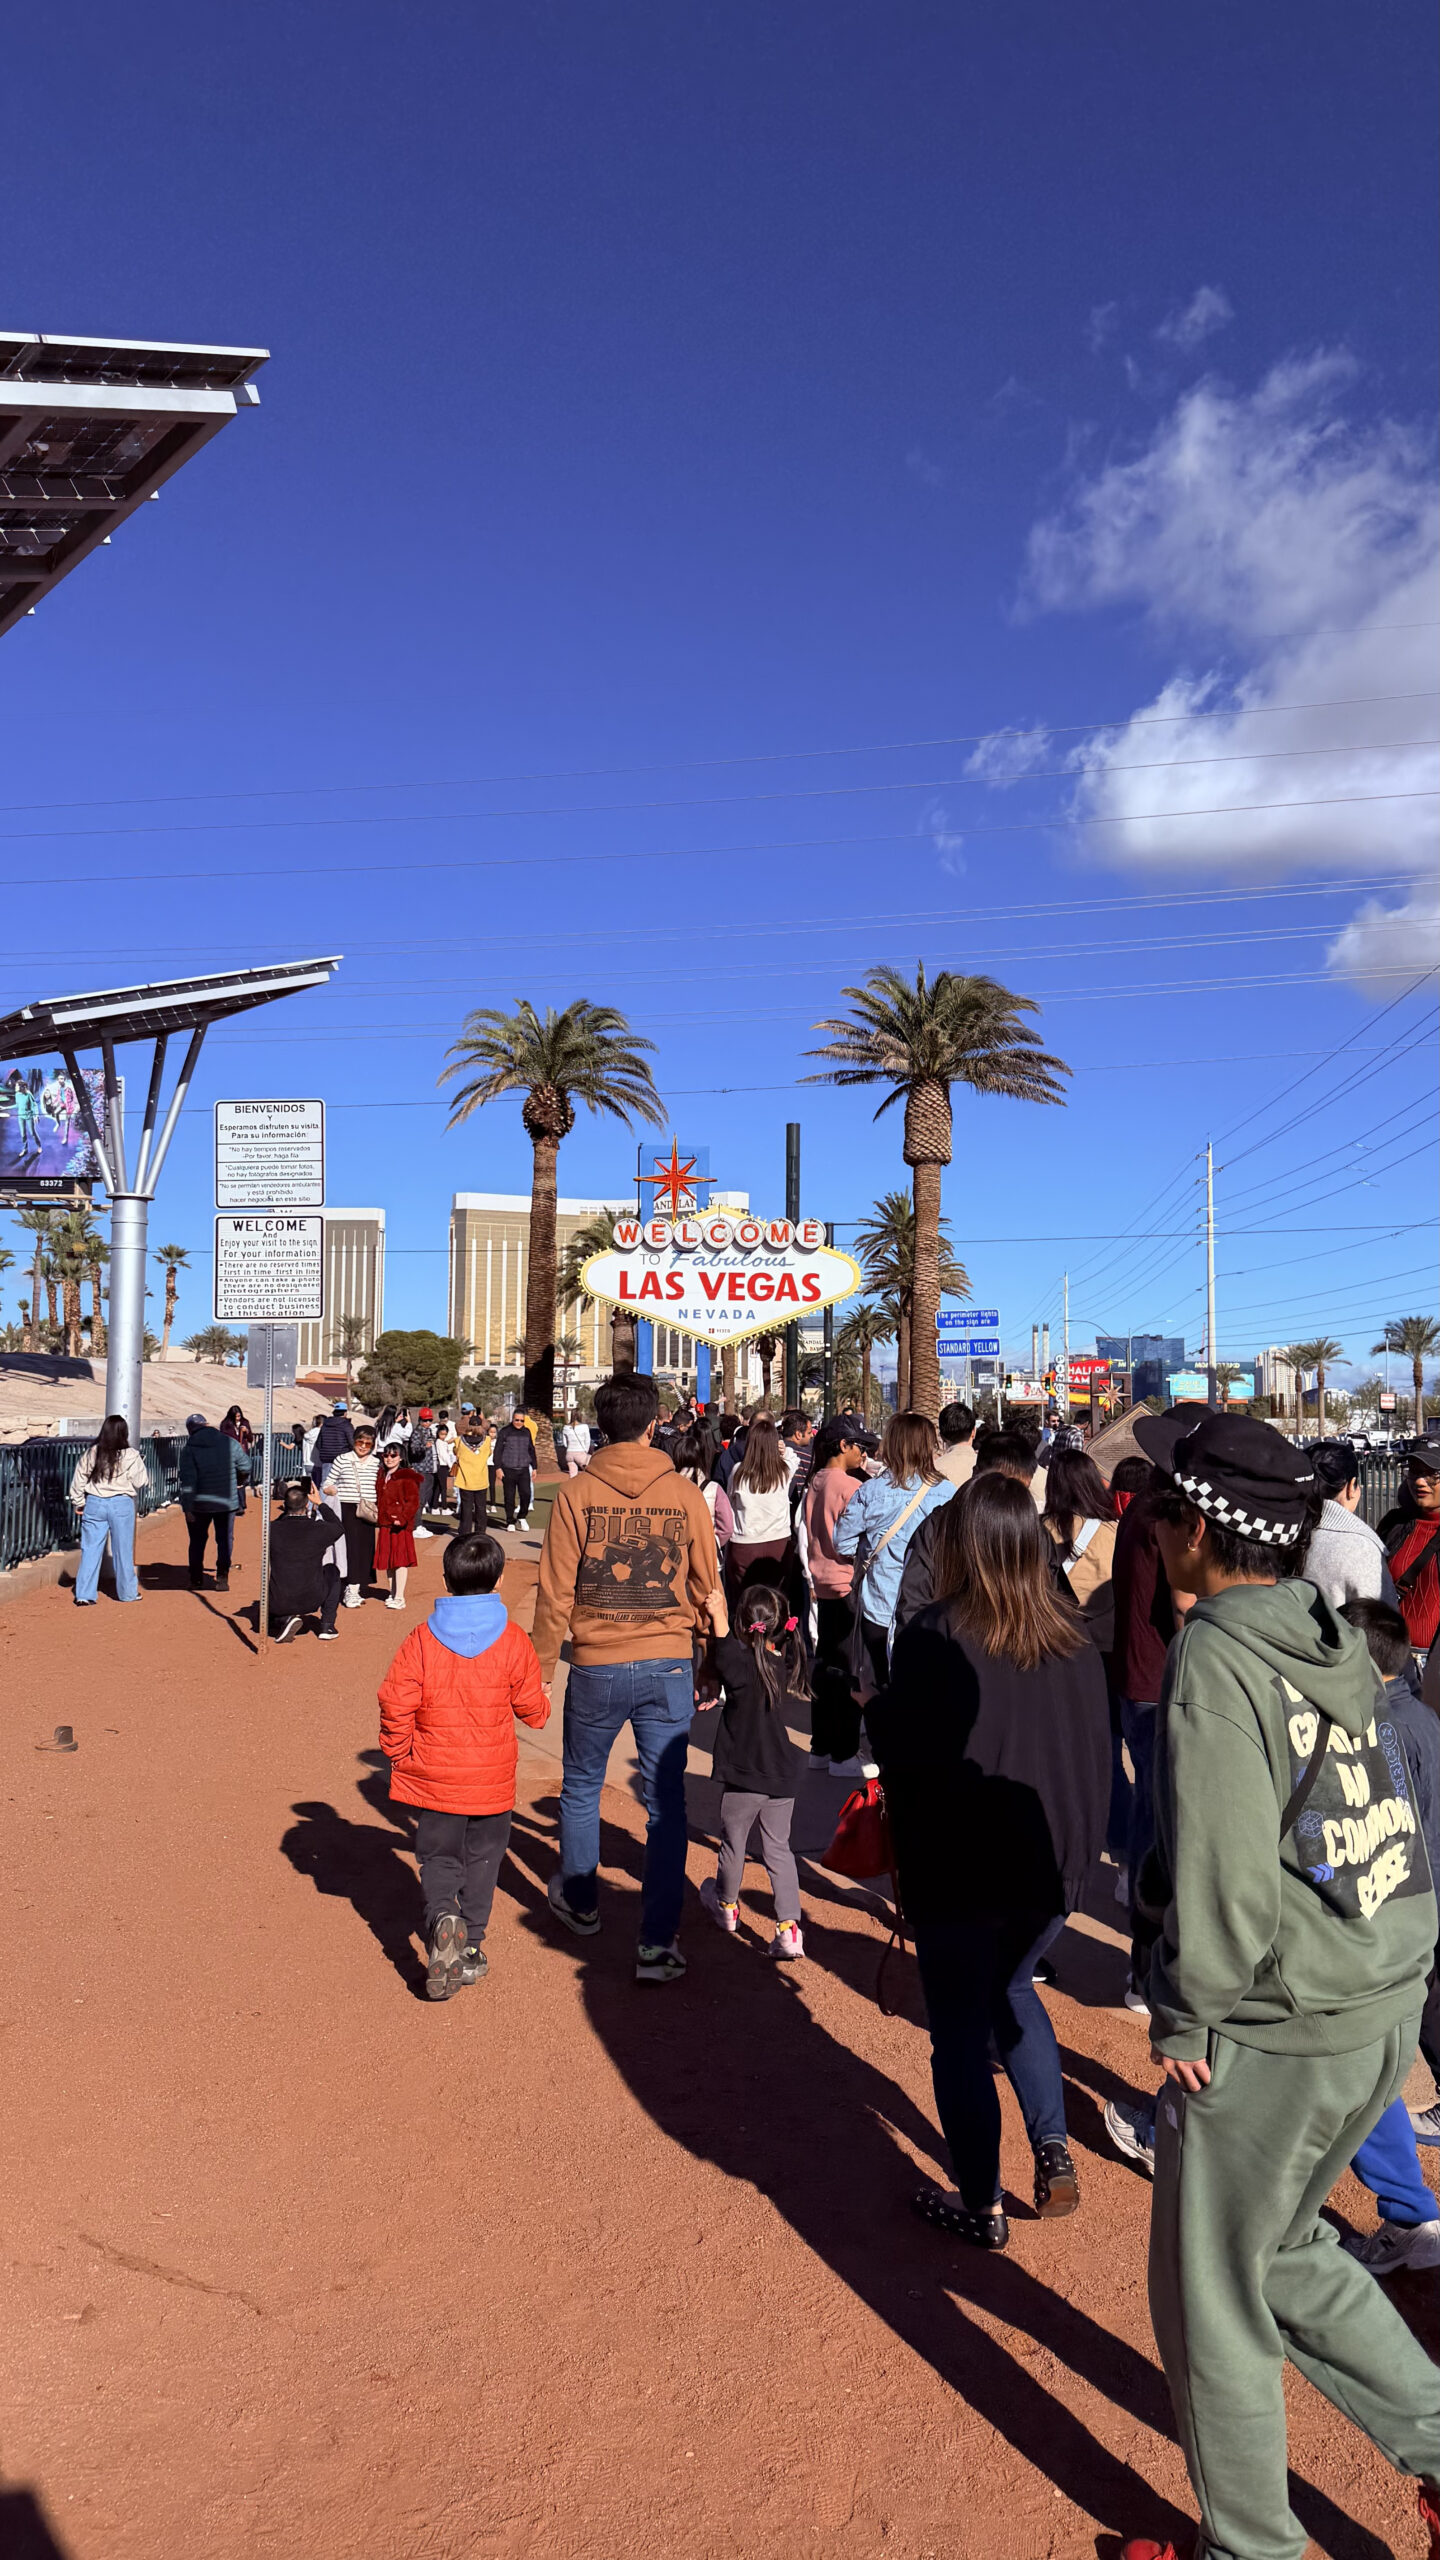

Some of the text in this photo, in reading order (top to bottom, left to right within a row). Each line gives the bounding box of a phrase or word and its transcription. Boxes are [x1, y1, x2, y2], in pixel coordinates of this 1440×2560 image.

[235, 1105, 305, 1113] BIENVENIDOS
[655, 1199, 694, 1210] ANDLAY
[233, 1220, 307, 1231] WELCOME
[616, 1223, 818, 1242] WELCOME
[221, 1239, 240, 1248] Enjoy
[243, 1240, 258, 1248] your
[262, 1239, 276, 1247] visit
[241, 1250, 261, 1259] your
[640, 1250, 795, 1268] TO Fabulous
[619, 1271, 821, 1302] LAS VEGAS
[678, 1309, 756, 1320] NEVADA
[939, 1342, 998, 1353] STANDARD YELLOW
[585, 1515, 651, 1543] BIG
[1322, 1797, 1416, 1868] COMMON
